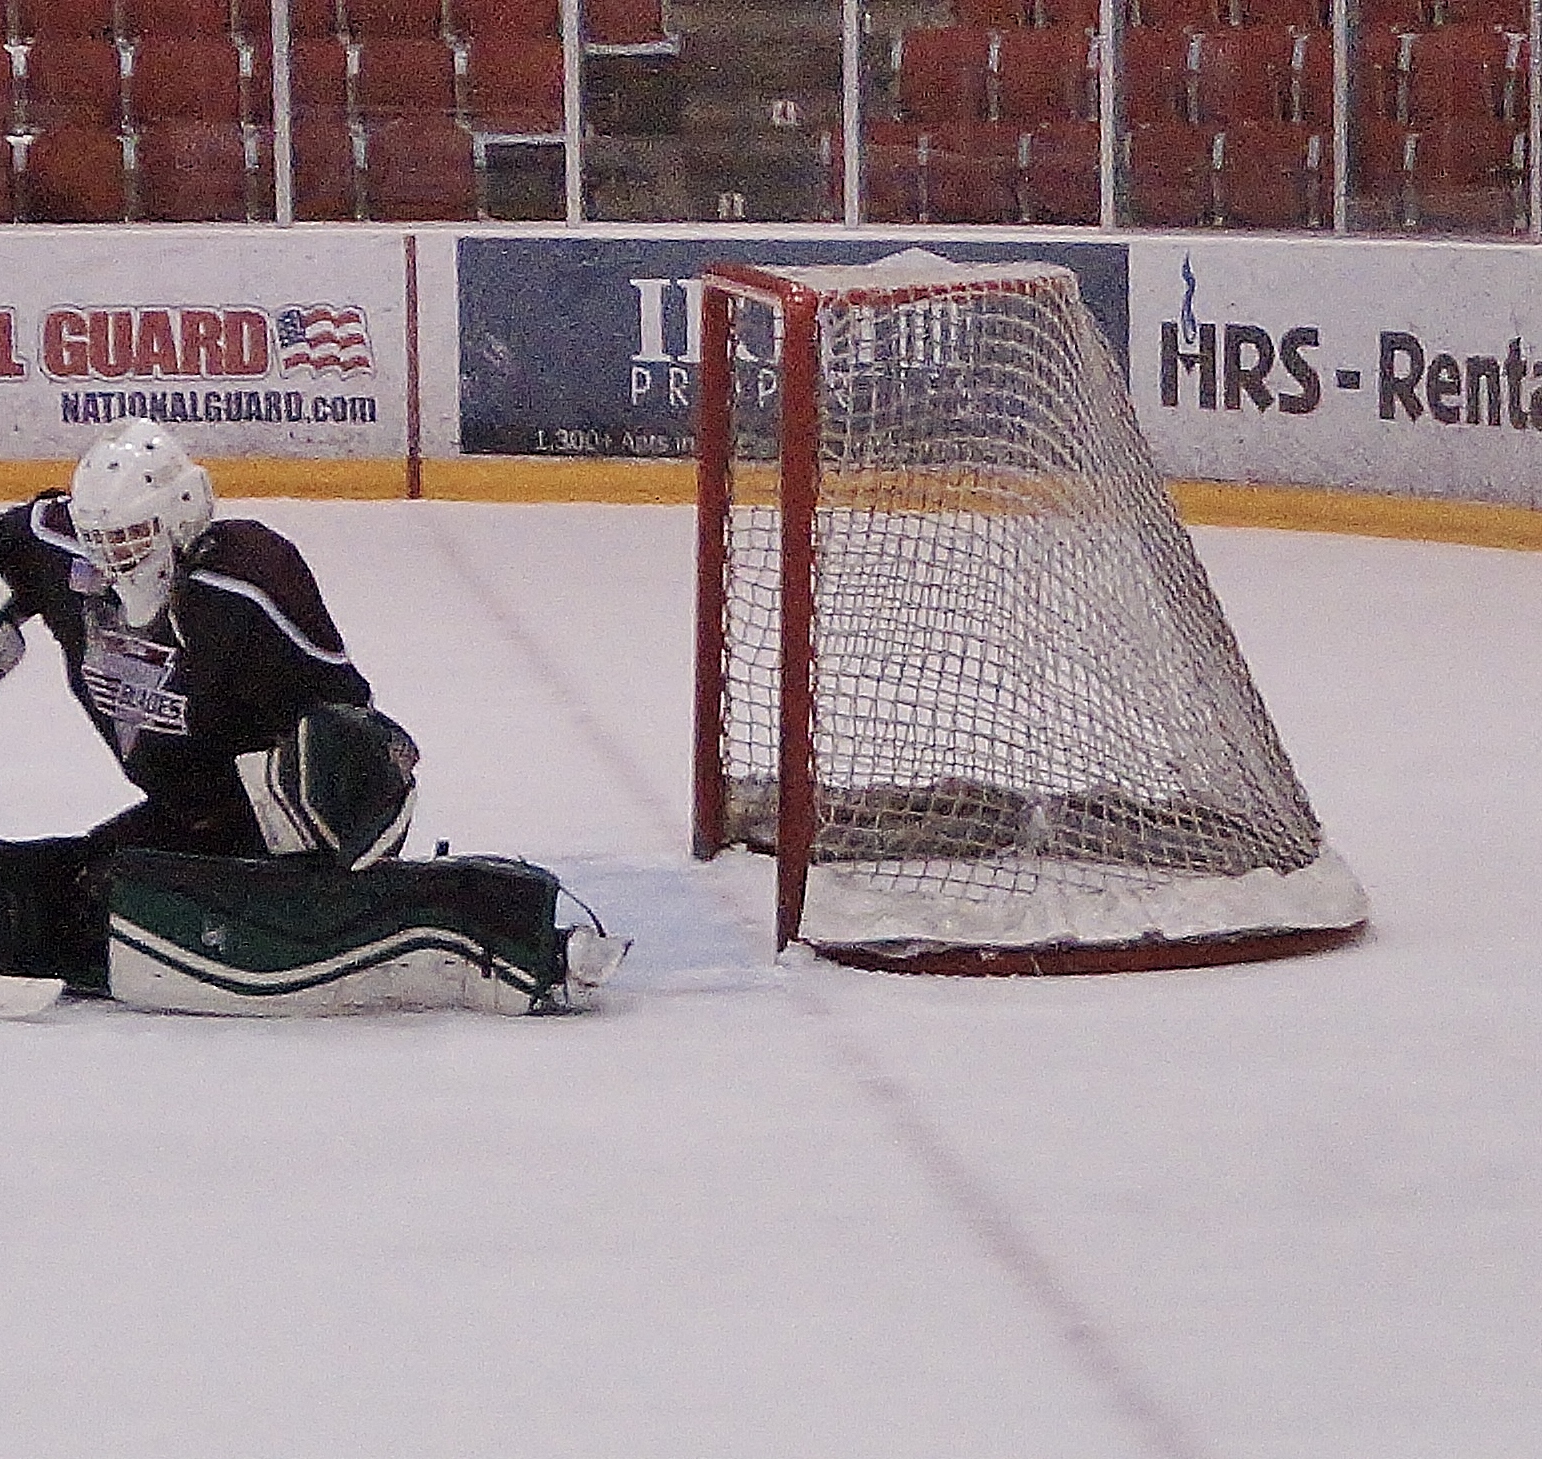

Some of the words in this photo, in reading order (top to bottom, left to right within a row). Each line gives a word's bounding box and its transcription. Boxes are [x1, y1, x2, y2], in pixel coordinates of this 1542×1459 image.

[40, 308, 271, 380] GUARD
[1160, 321, 1321, 414] HRS
[61, 391, 376, 423] NATIONALGUARD.com
